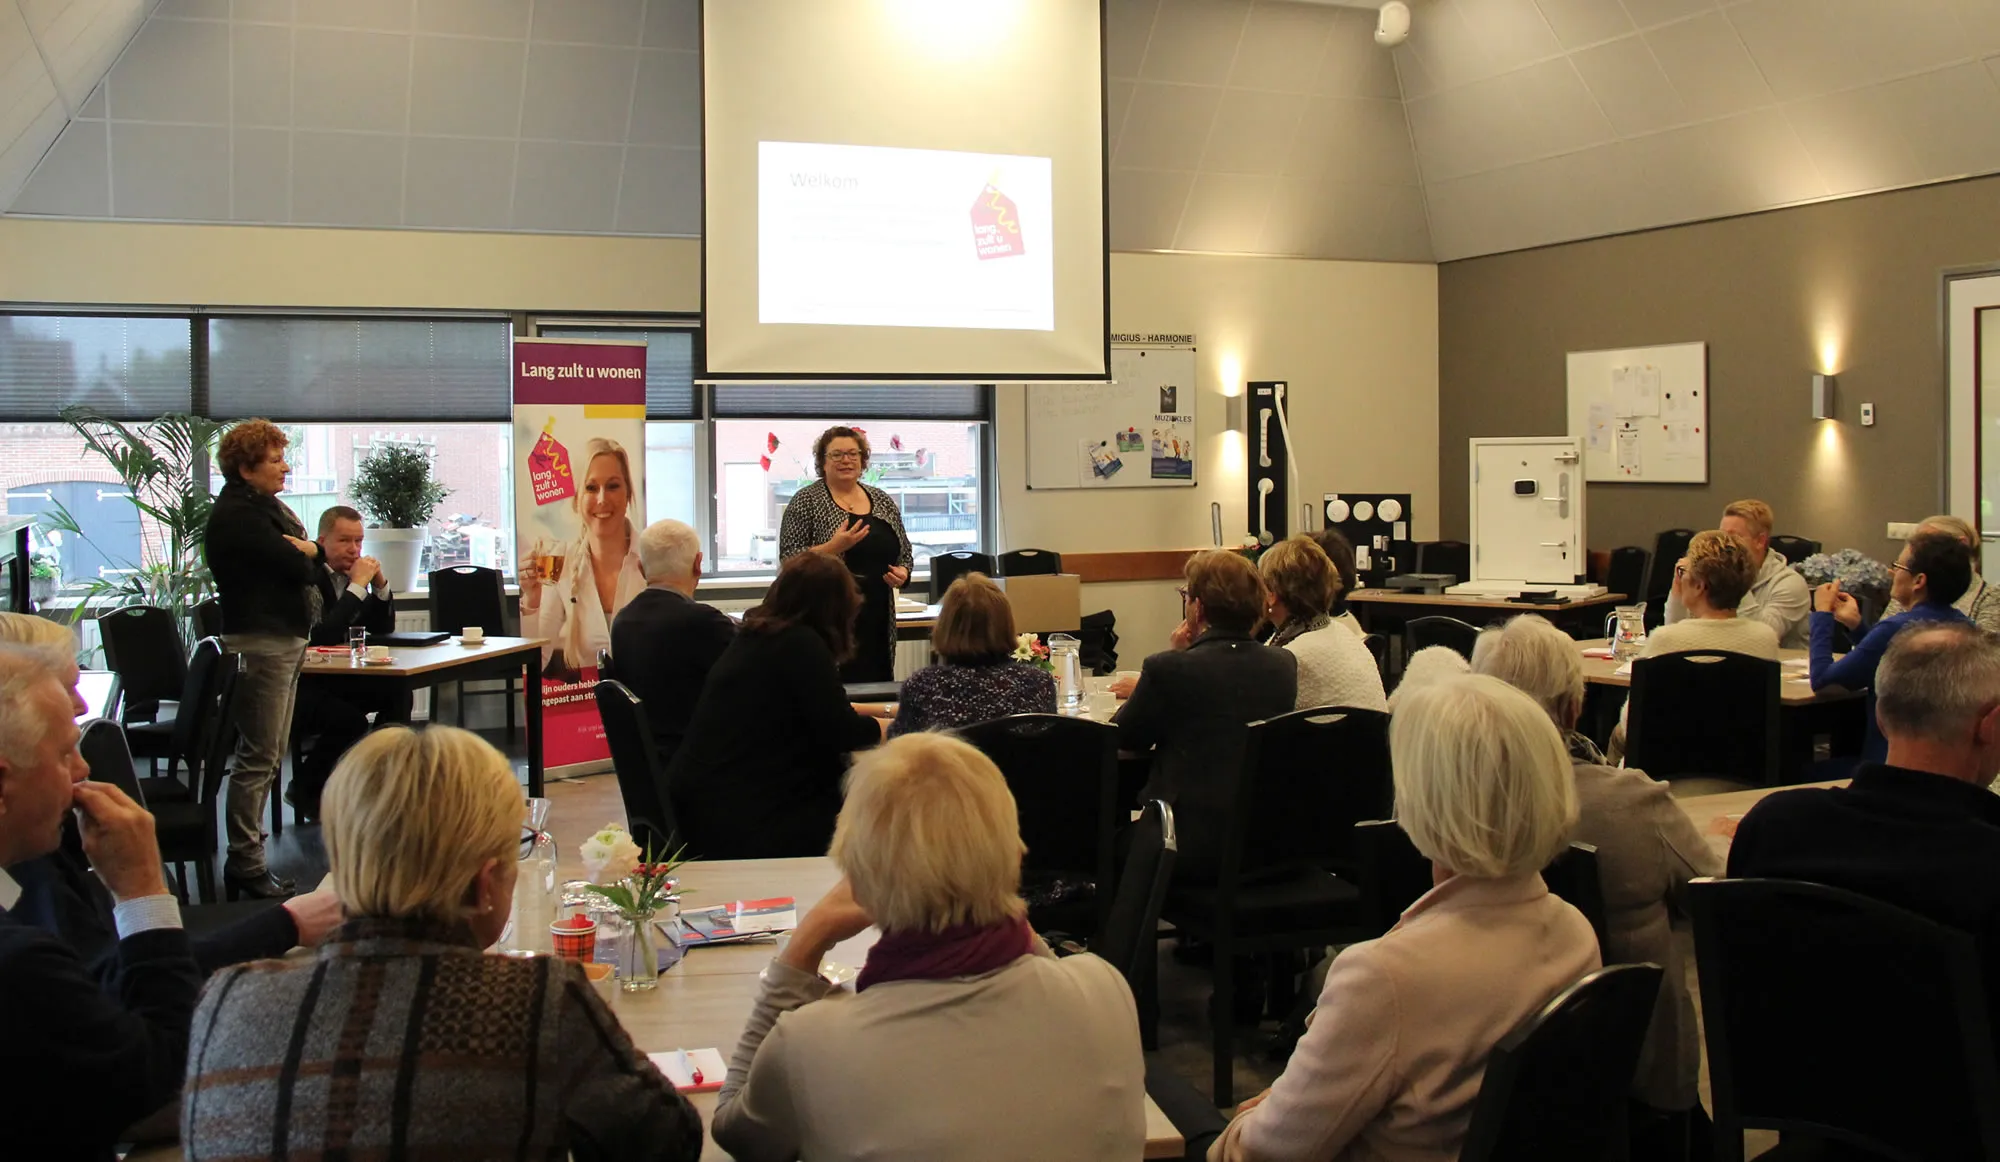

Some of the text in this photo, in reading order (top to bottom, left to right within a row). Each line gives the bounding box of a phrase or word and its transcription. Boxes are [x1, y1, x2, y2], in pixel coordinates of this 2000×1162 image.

[789, 172, 859, 189] Welkom
[1147, 334, 1192, 343] HARMONIE
[521, 362, 642, 380] Lang zult u wonen
[1154, 414, 1192, 423] MUZIKLES
[535, 479, 558, 492] zult u
[537, 487, 564, 501] wonen
[542, 685, 552, 694] ijn
[554, 683, 577, 691] ouders
